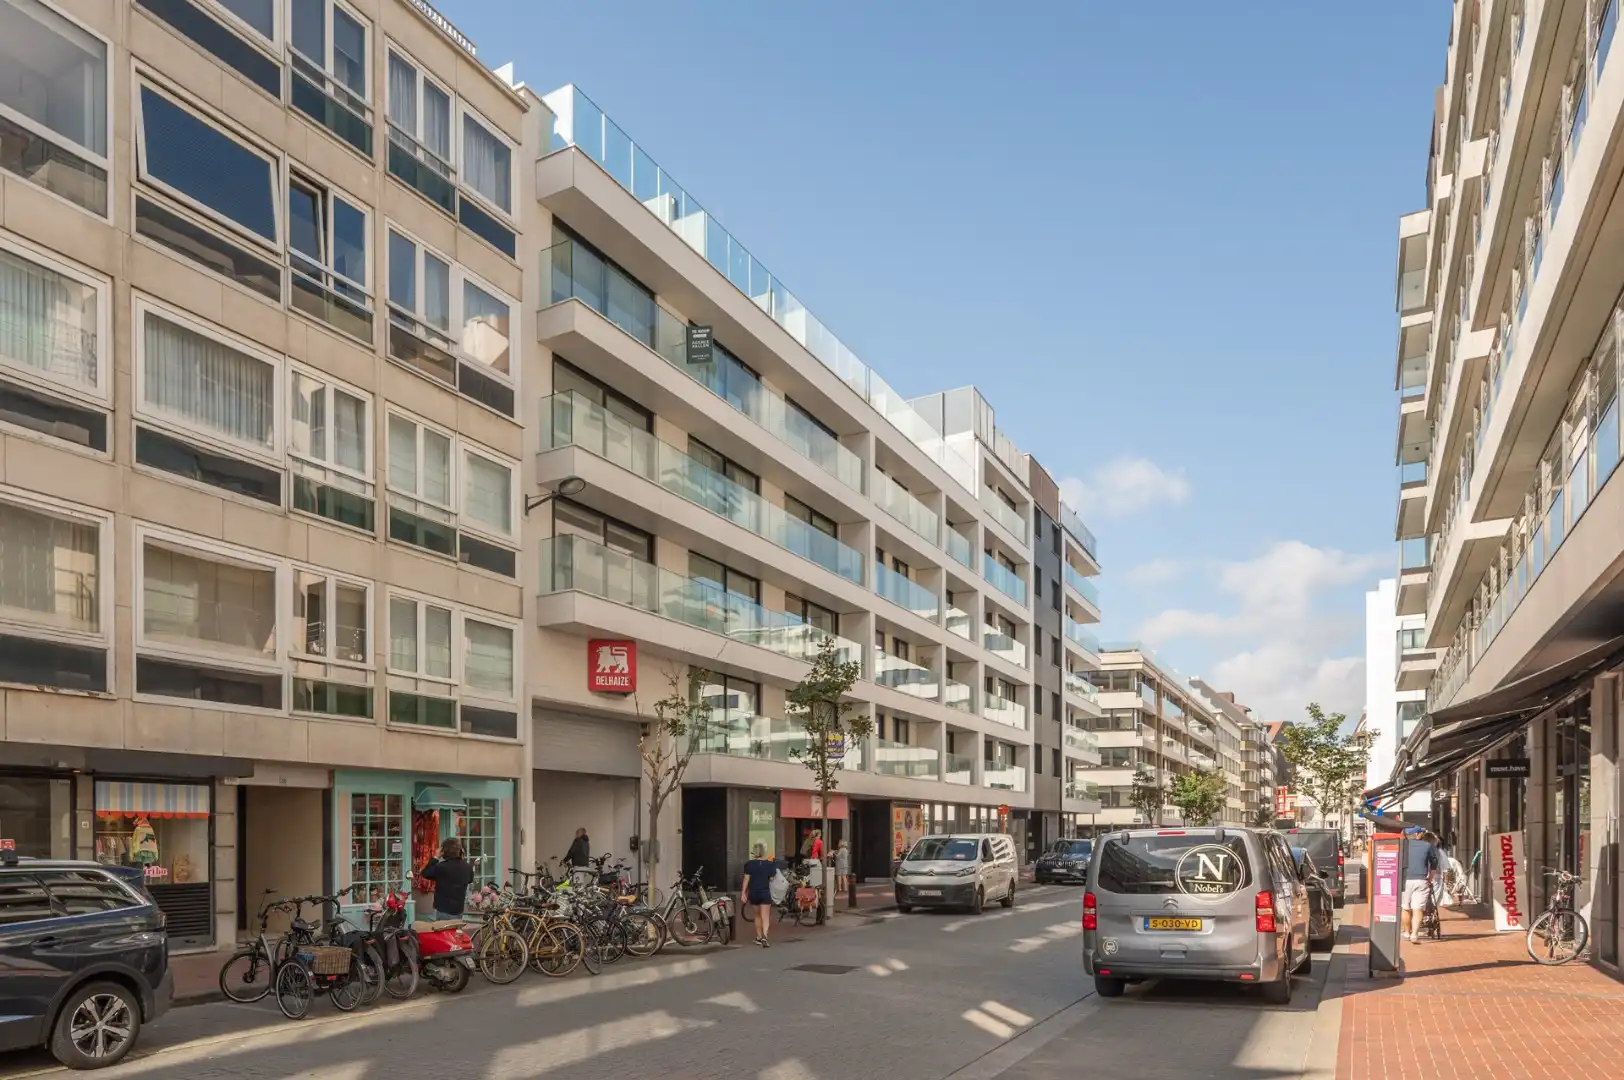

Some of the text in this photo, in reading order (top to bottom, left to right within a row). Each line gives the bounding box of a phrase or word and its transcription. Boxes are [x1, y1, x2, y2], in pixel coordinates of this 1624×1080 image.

[595, 675, 630, 686] DELHAIZE
[1194, 852, 1228, 880] N
[1499, 835, 1523, 926] zoutepeople
[1194, 883, 1224, 893] Nobel's
[1152, 919, 1198, 928] S-030-VD
